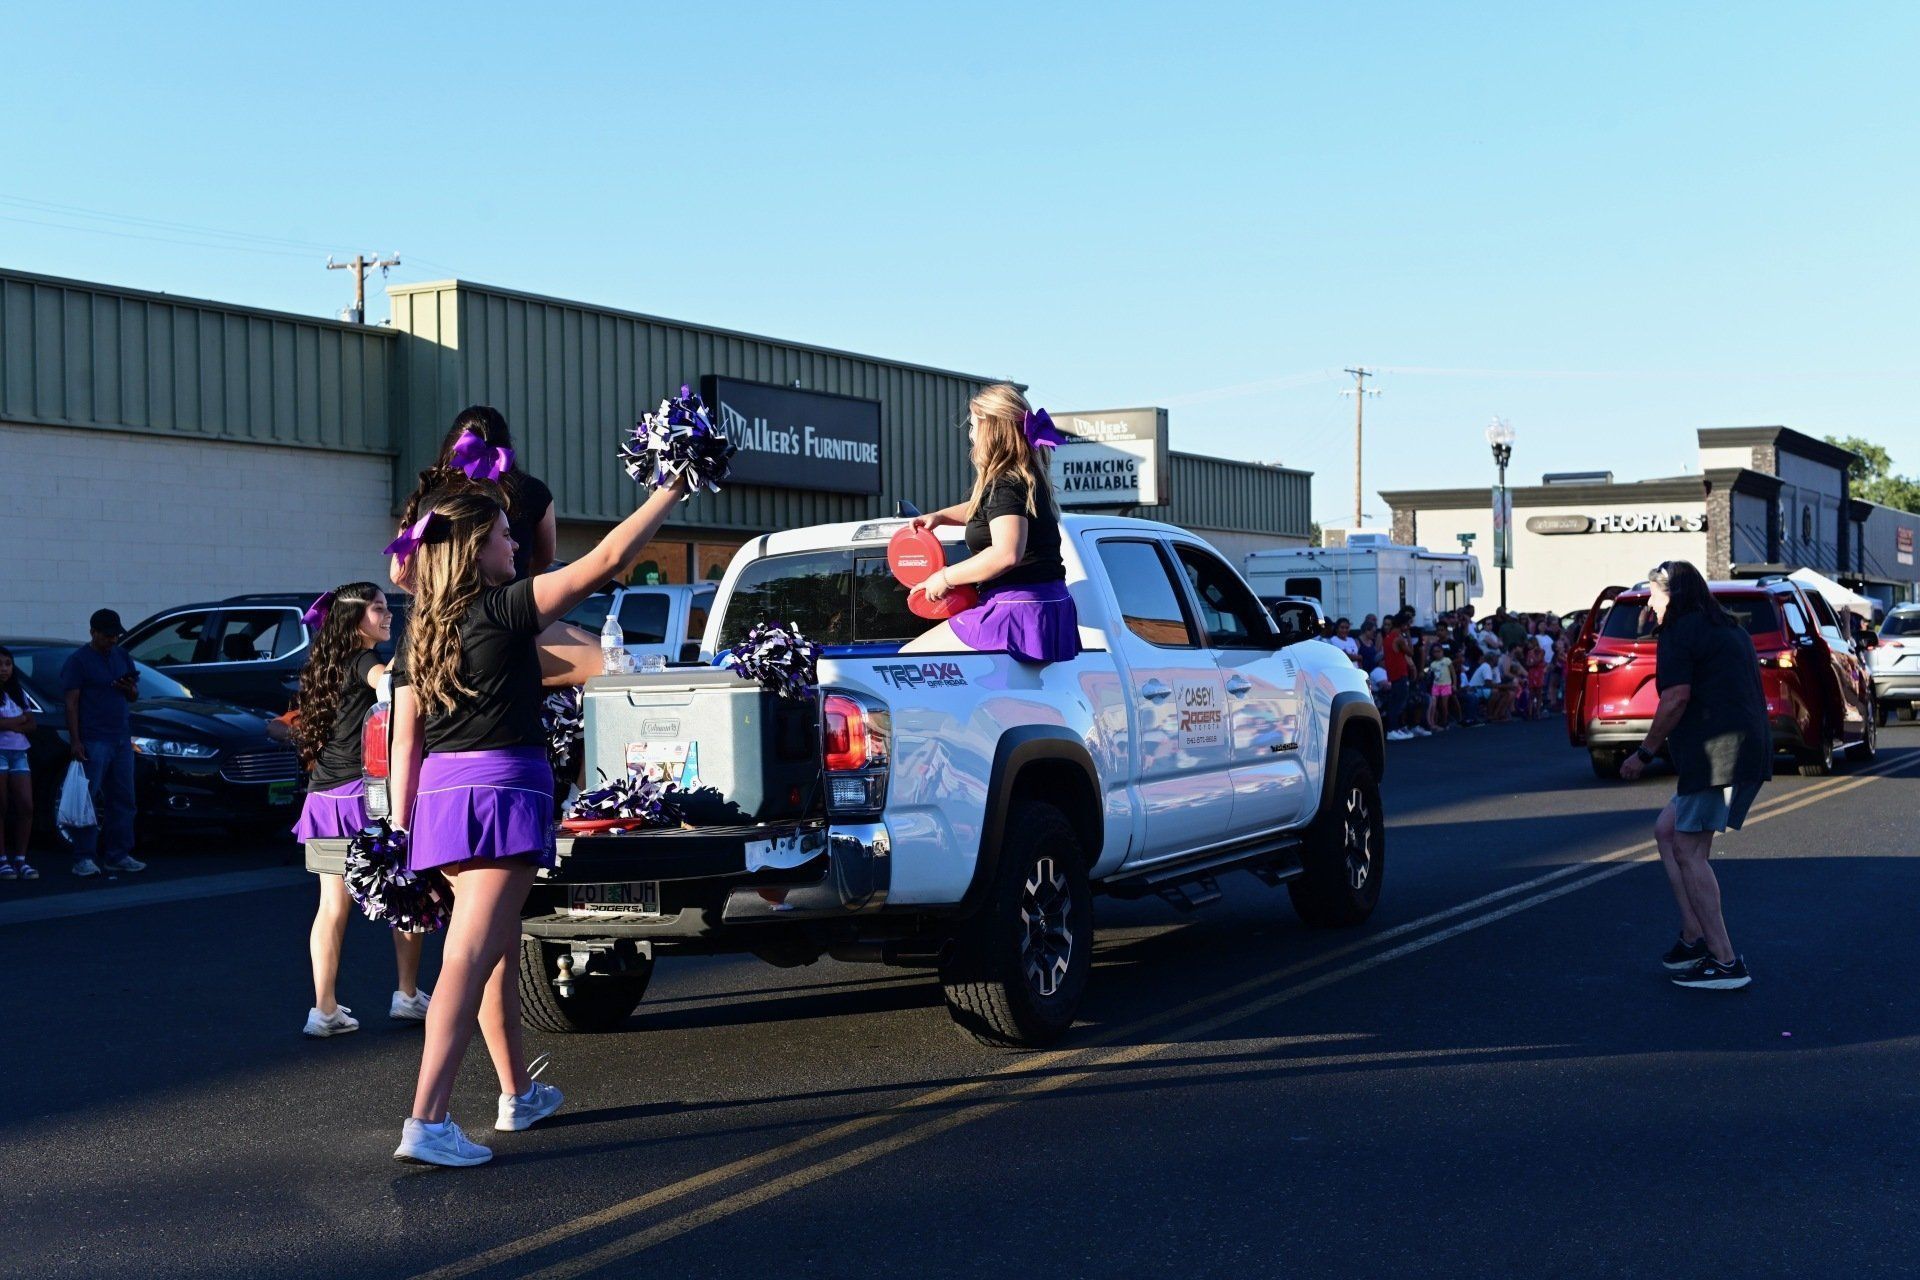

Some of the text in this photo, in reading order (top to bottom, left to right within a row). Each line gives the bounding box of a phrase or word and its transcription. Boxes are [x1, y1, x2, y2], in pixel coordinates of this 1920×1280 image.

[804, 425, 878, 464] FURNITURE
[1063, 459, 1134, 475] FINANCING
[1064, 475, 1138, 491] AVAILABLE
[1596, 512, 1680, 532] FLORAL
[872, 662, 964, 690] TRD 4X4
[1185, 686, 1215, 708] CASEY!
[1180, 710, 1221, 732] ROGERS
[589, 904, 640, 912] ROGERS
